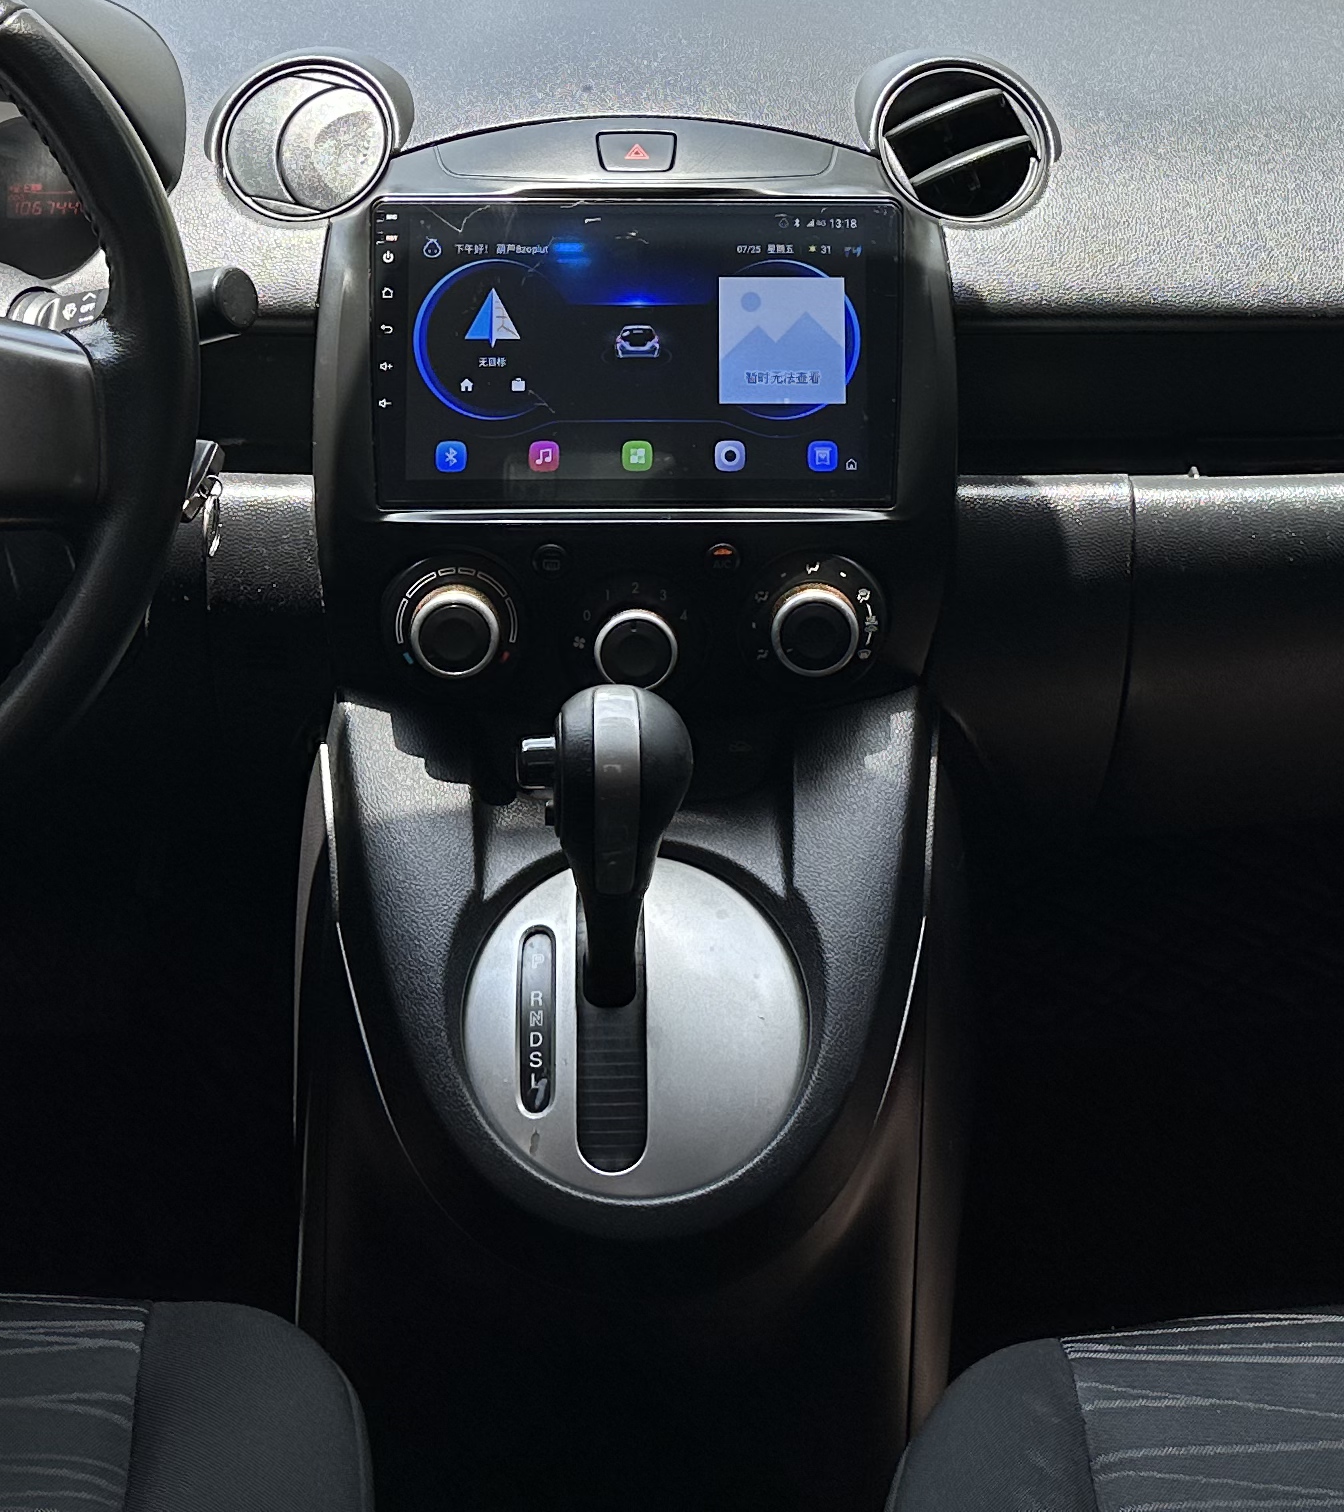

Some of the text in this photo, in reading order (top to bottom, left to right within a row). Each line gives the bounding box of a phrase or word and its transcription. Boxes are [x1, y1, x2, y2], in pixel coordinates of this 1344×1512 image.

[829, 218, 858, 229] 13:18
[736, 245, 762, 254] 07/25
[767, 243, 795, 254] 星期五
[745, 370, 820, 385] 暂时无法查看
[605, 589, 610, 601] 1
[631, 581, 640, 595] 2
[659, 589, 668, 602] 3
[582, 609, 592, 622] 0
[679, 608, 688, 622] 4
[532, 953, 545, 969] P
[530, 990, 543, 1007] R
[529, 1009, 544, 1027] N
[529, 1031, 543, 1048] D
[529, 1051, 543, 1068] S
